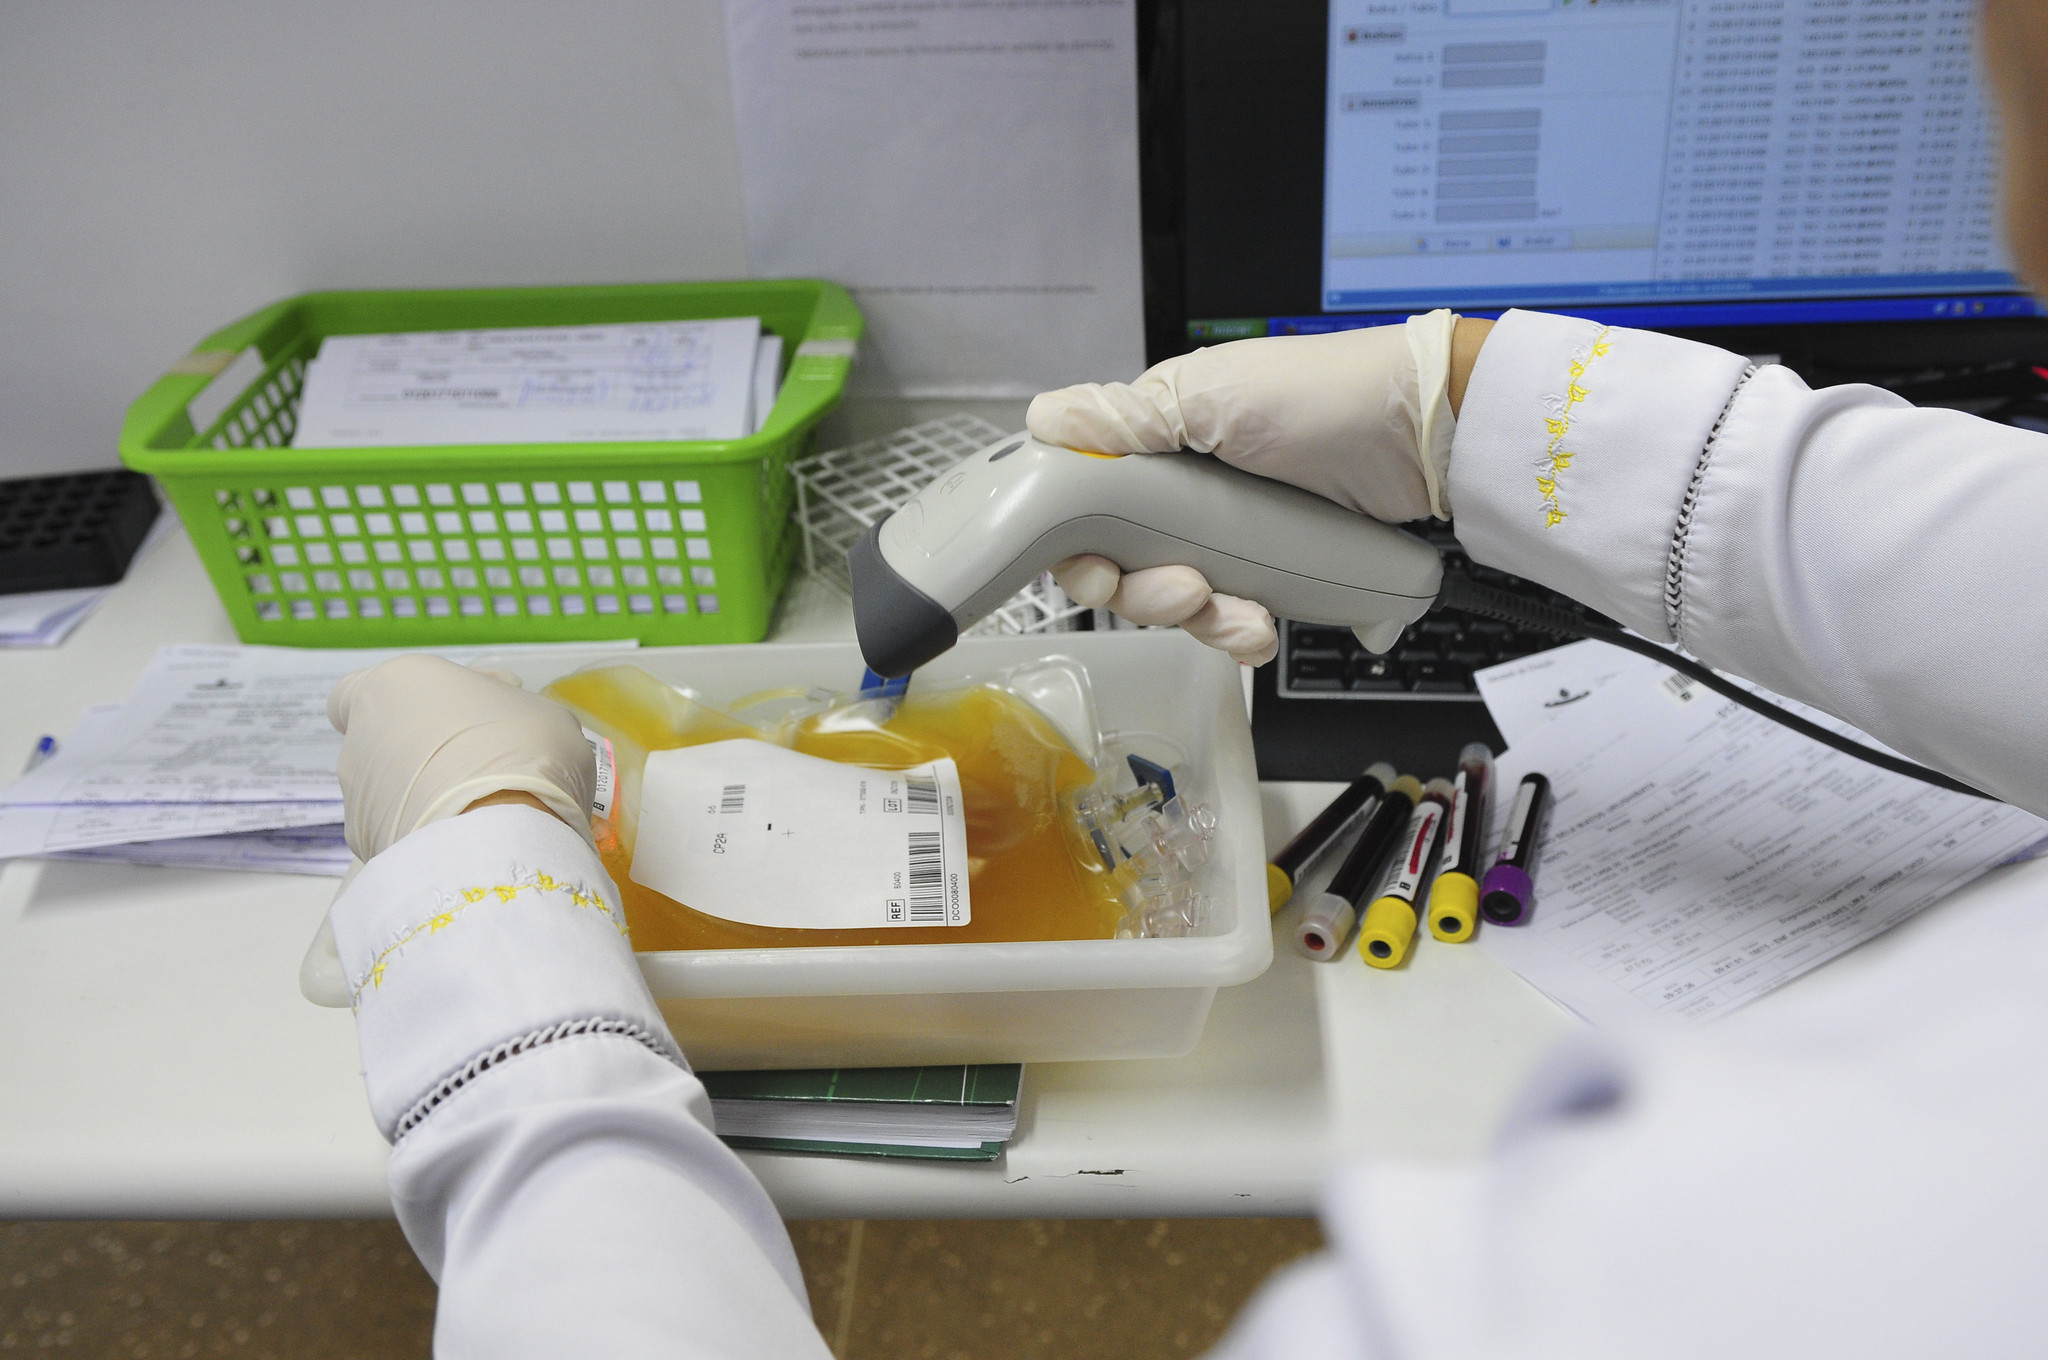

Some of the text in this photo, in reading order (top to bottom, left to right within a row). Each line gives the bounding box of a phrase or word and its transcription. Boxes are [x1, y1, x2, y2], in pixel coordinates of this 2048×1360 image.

[888, 799, 898, 811] LOT
[712, 832, 727, 855] CP2A
[890, 901, 902, 920] REF
